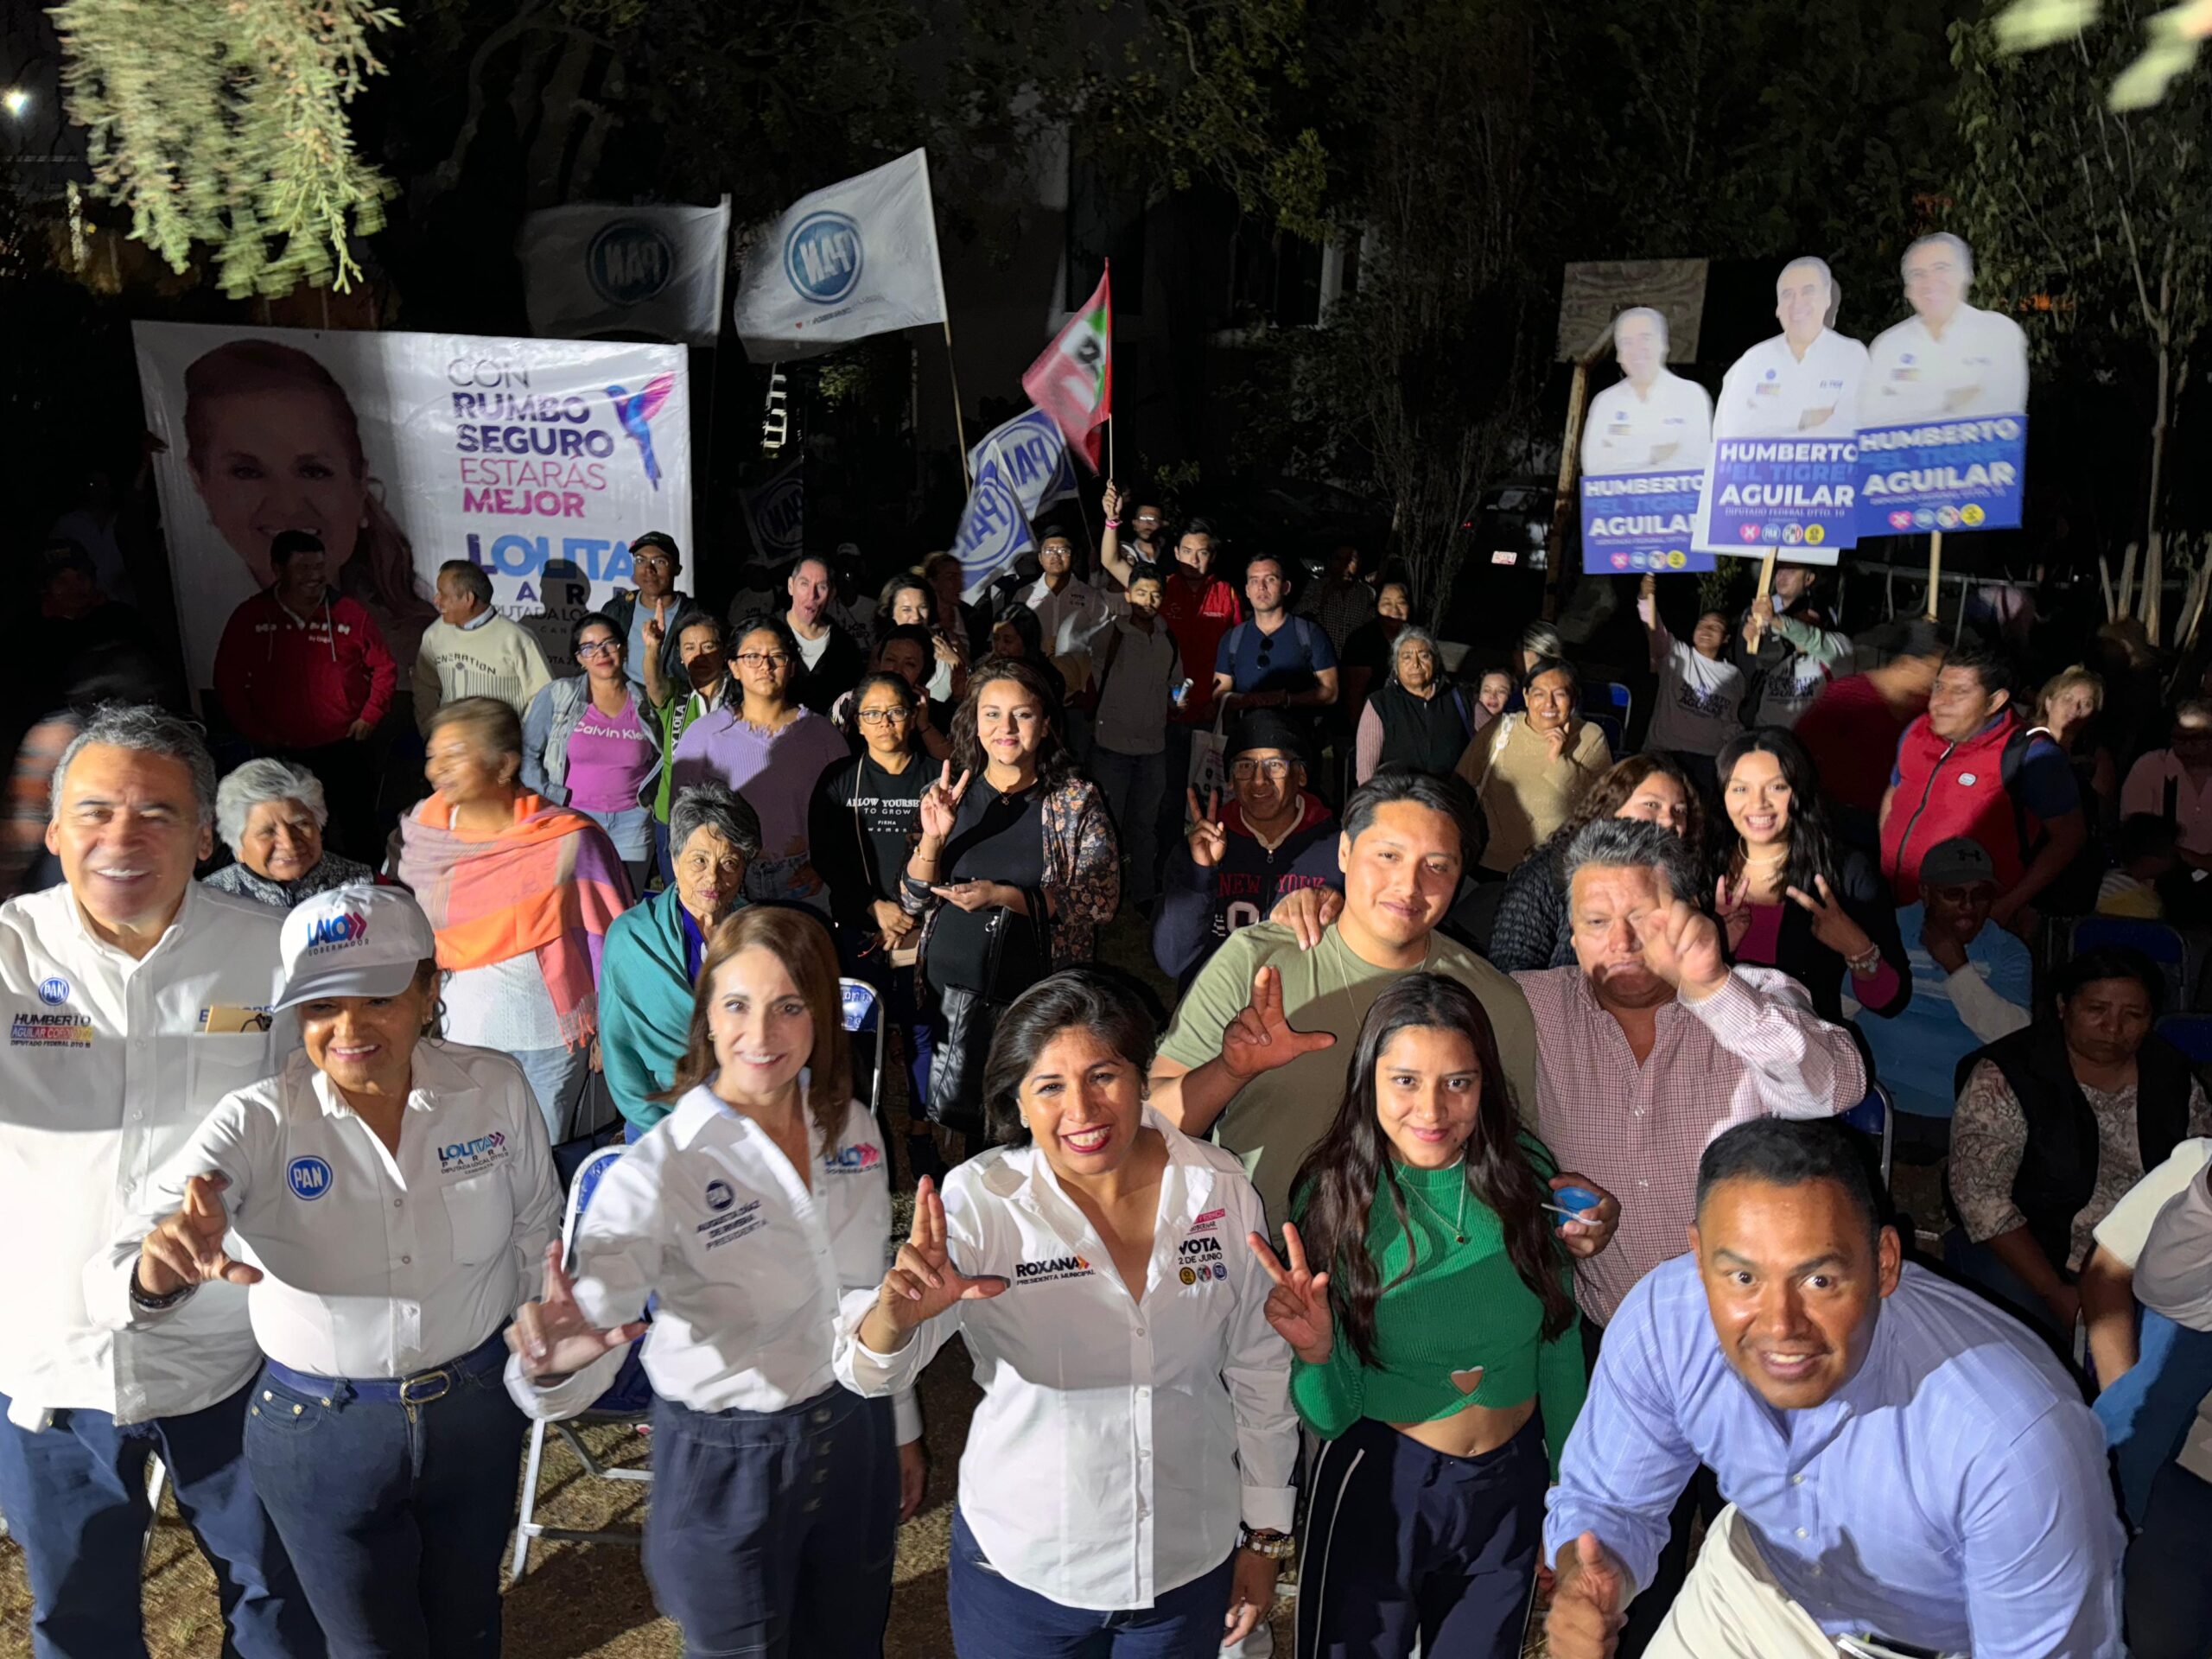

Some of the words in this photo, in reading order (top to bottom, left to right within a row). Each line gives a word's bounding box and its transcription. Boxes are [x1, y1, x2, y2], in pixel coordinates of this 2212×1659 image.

[448, 358, 531, 388] CON
[452, 391, 591, 423] RUMBO
[455, 423, 614, 459] SEGURO
[1859, 418, 2020, 452] HUMBERTO
[1719, 442, 1858, 463] HUMBERTO
[461, 454, 607, 492] ESTARÁS
[1861, 461, 2017, 496] AGUILAR
[1585, 475, 1704, 497] HUMBERTO
[1719, 484, 1856, 507] AGUILAR
[463, 487, 586, 518] MEJOR
[466, 533, 635, 582] LOLITA
[672, 703, 686, 734] LOLA
[574, 721, 620, 739] Calvin
[622, 728, 645, 741] Kle
[845, 798, 880, 807] ALLOW
[881, 798, 920, 808] YOURSE
[1217, 873, 1262, 897] NEW
[307, 916, 350, 947] LALO
[308, 938, 370, 957] GOBERNADOR
[44, 982, 64, 998] PAN
[14, 1014, 92, 1027] HUMBERTO
[12, 1027, 47, 1039] AGUILAR
[437, 1135, 493, 1161] LOLITA
[442, 1146, 507, 1167] PARRA
[293, 1166, 324, 1192] PAN
[1179, 1236, 1222, 1255] VOTA
[1015, 1255, 1080, 1277] ROXANA
[1178, 1256, 1185, 1265] 2
[1185, 1255, 1197, 1264] DE
[1198, 1252, 1223, 1262] JUNIO
[1016, 1274, 1059, 1286] PRESIDENTA
[1061, 1269, 1096, 1280] MUNICIPAL
